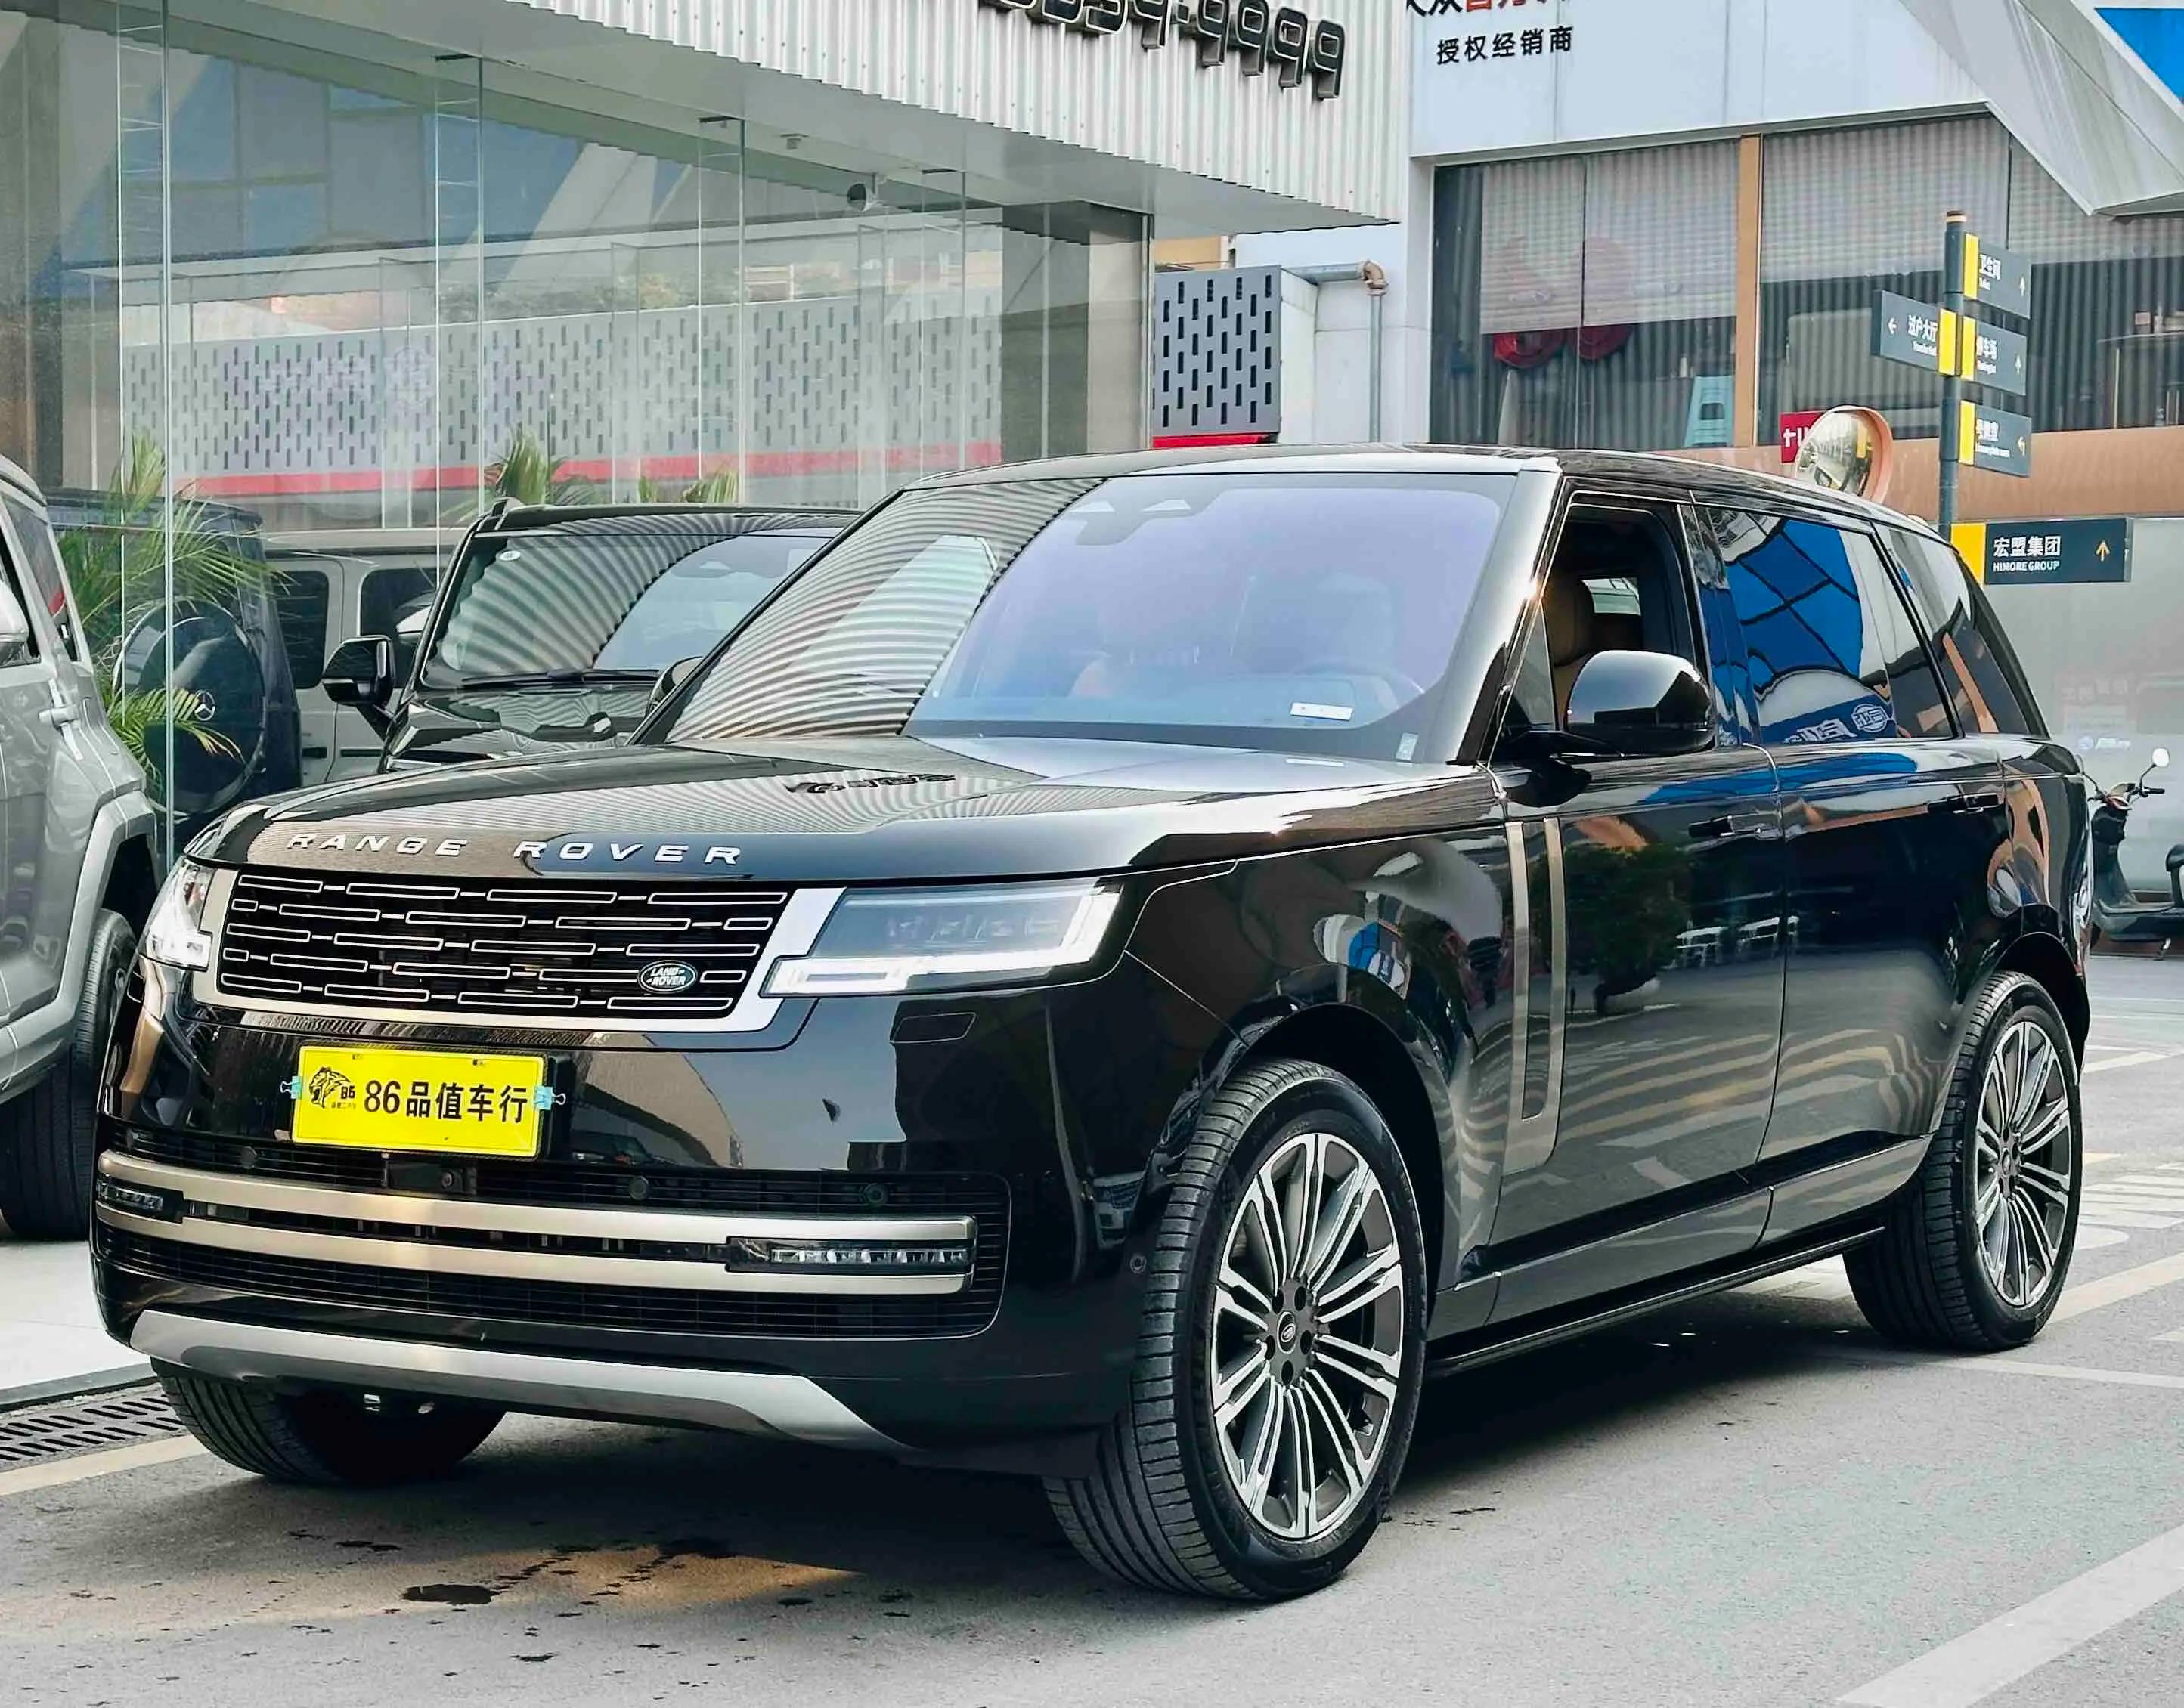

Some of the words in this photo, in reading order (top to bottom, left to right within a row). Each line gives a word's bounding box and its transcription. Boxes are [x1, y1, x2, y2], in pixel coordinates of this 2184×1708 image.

[1437, 26, 1573, 65] 授权经销商
[1993, 536, 2061, 557] 宏盟集团
[1993, 561, 2028, 572] HIMORE
[2028, 561, 2060, 571] GROUP
[287, 833, 468, 857] RANGE
[513, 840, 742, 865] ROVER
[650, 967, 680, 976] LAND
[651, 976, 686, 986] ROVER
[341, 1085, 355, 1099] 86
[364, 1080, 528, 1123] 86品值车行
